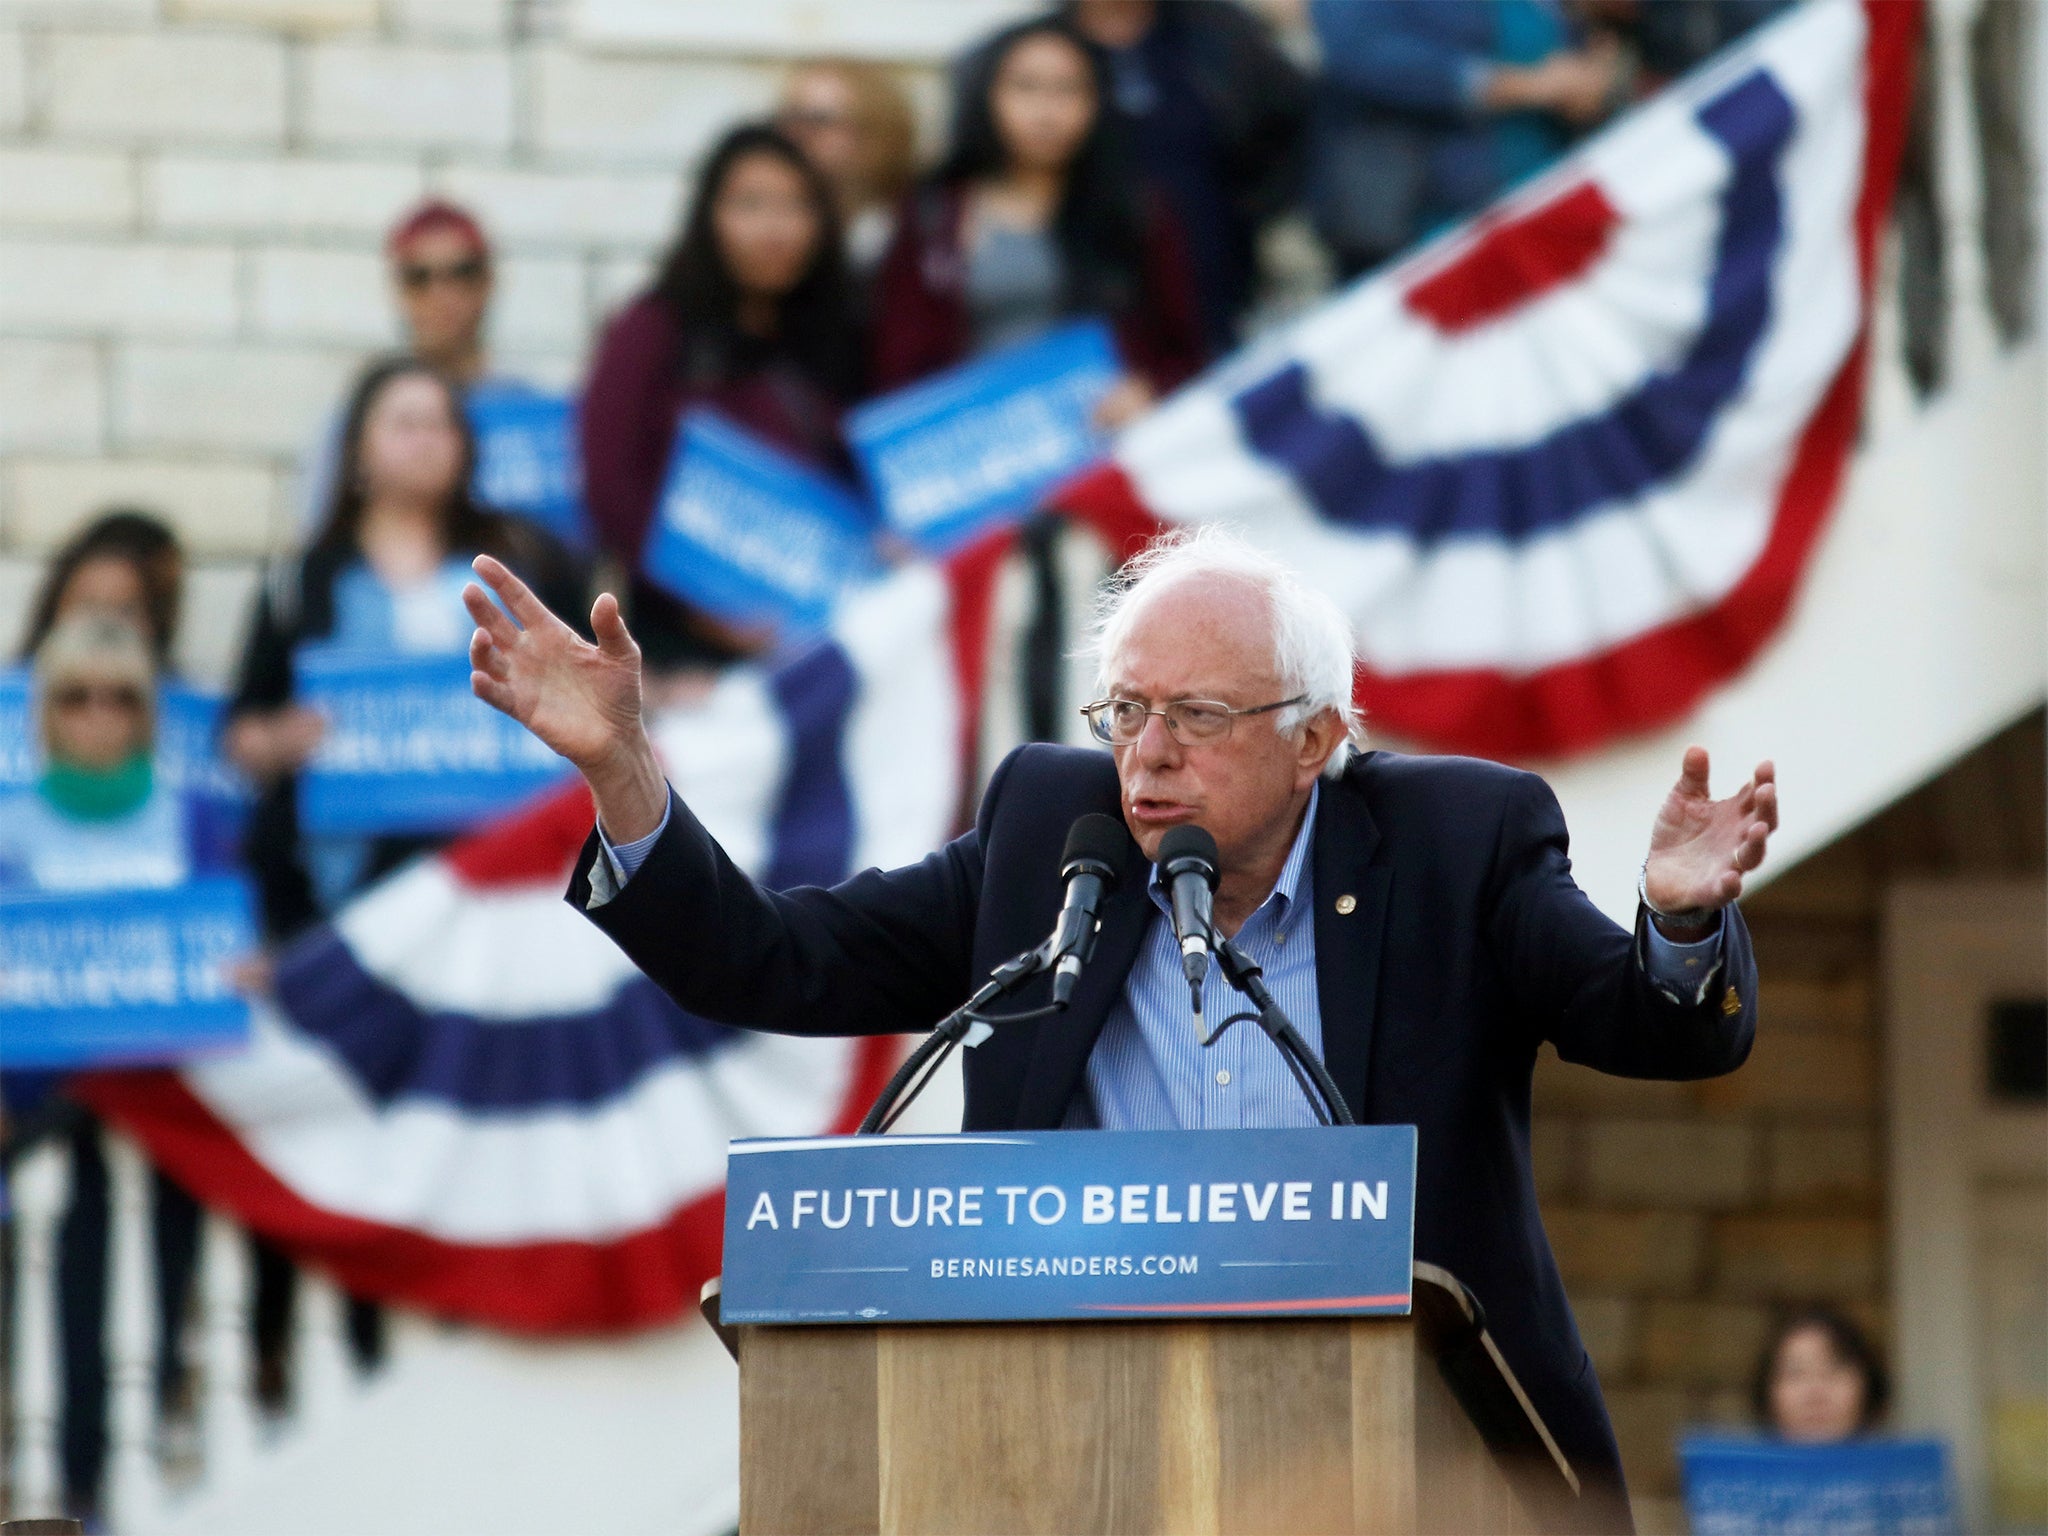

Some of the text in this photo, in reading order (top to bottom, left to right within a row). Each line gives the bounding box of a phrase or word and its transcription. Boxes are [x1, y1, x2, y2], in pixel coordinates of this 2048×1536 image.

[746, 1180, 1389, 1231] A FUTURE TO BELIEVE IN
[930, 1254, 1198, 1278] BERNIESANDERS.COM
